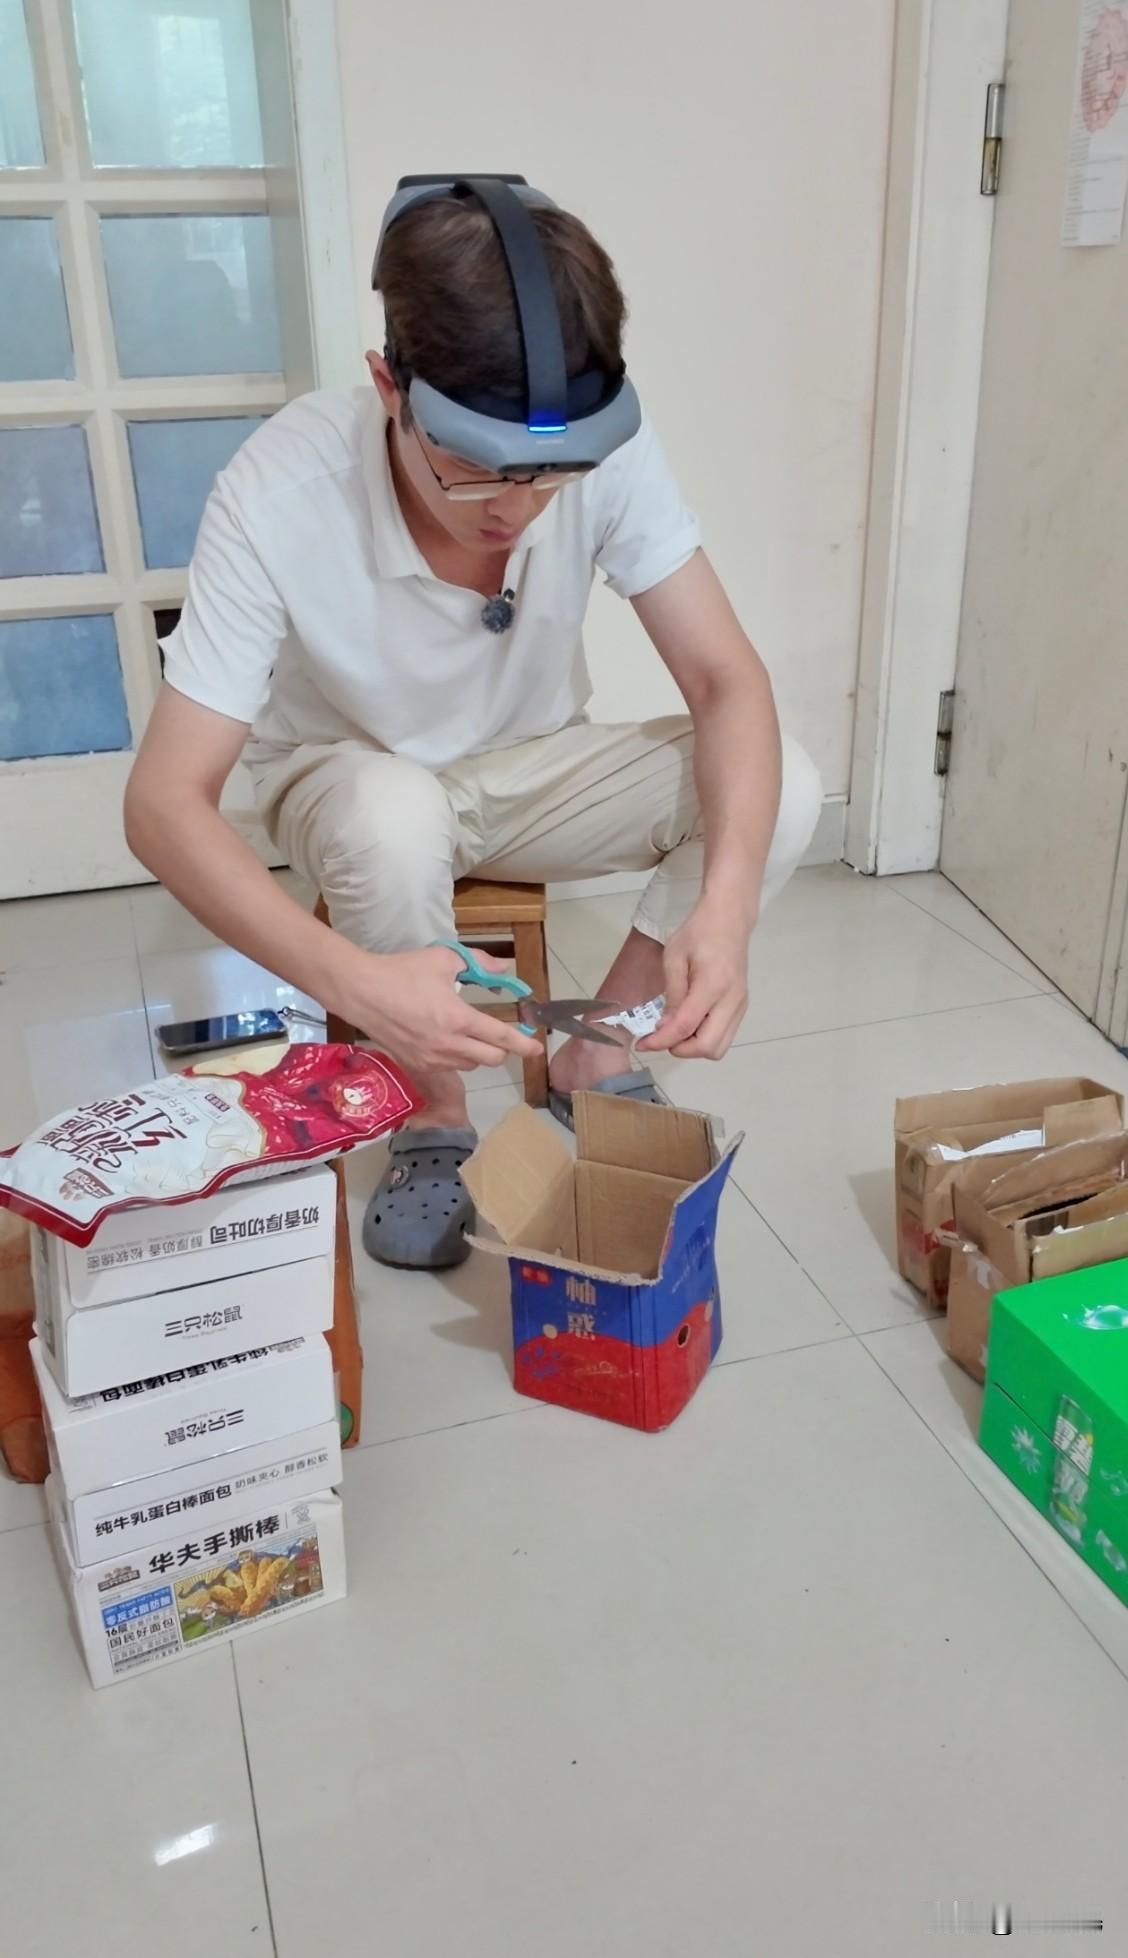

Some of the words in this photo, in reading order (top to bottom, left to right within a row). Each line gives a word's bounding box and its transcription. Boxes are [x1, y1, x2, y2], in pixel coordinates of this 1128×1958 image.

[210, 1205, 320, 1245] 奶香厚切吐司
[164, 1304, 243, 1338] 三只松鼠
[165, 1409, 244, 1446] 三只松鼠
[95, 1484, 232, 1537] 纯牛乳蛋白棒面包
[148, 1514, 281, 1575] 华夫手撕棒
[109, 1618, 175, 1649] 国民好面包
